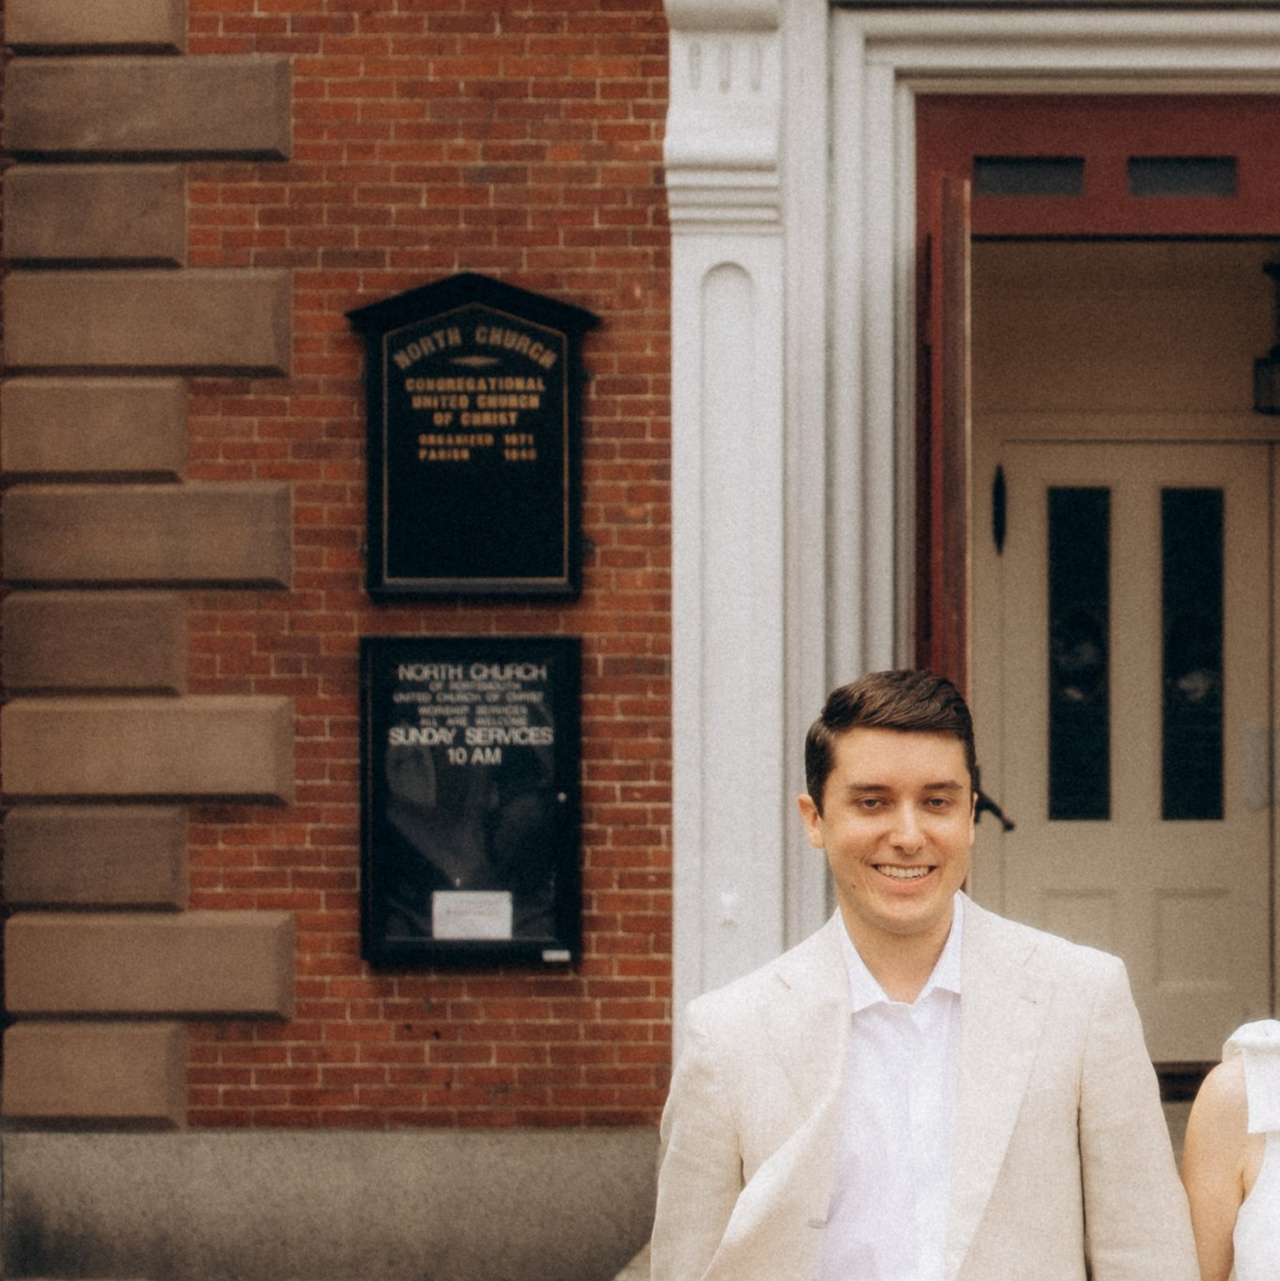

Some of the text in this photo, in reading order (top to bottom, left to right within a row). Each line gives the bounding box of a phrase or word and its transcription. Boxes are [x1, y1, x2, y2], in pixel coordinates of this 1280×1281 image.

[393, 326, 558, 369] NORTH CHURCH
[405, 377, 546, 392] CONGREGATIONAL
[411, 394, 540, 409] UNITED CHURCH
[432, 411, 518, 426] OF CHRIST
[418, 433, 494, 446] ORGANIZED
[418, 448, 470, 461] PARISH
[398, 663, 548, 681] NORTH CHURCH
[388, 727, 555, 746] SUNDAY SERVICES
[447, 747, 502, 765] 10 AM
